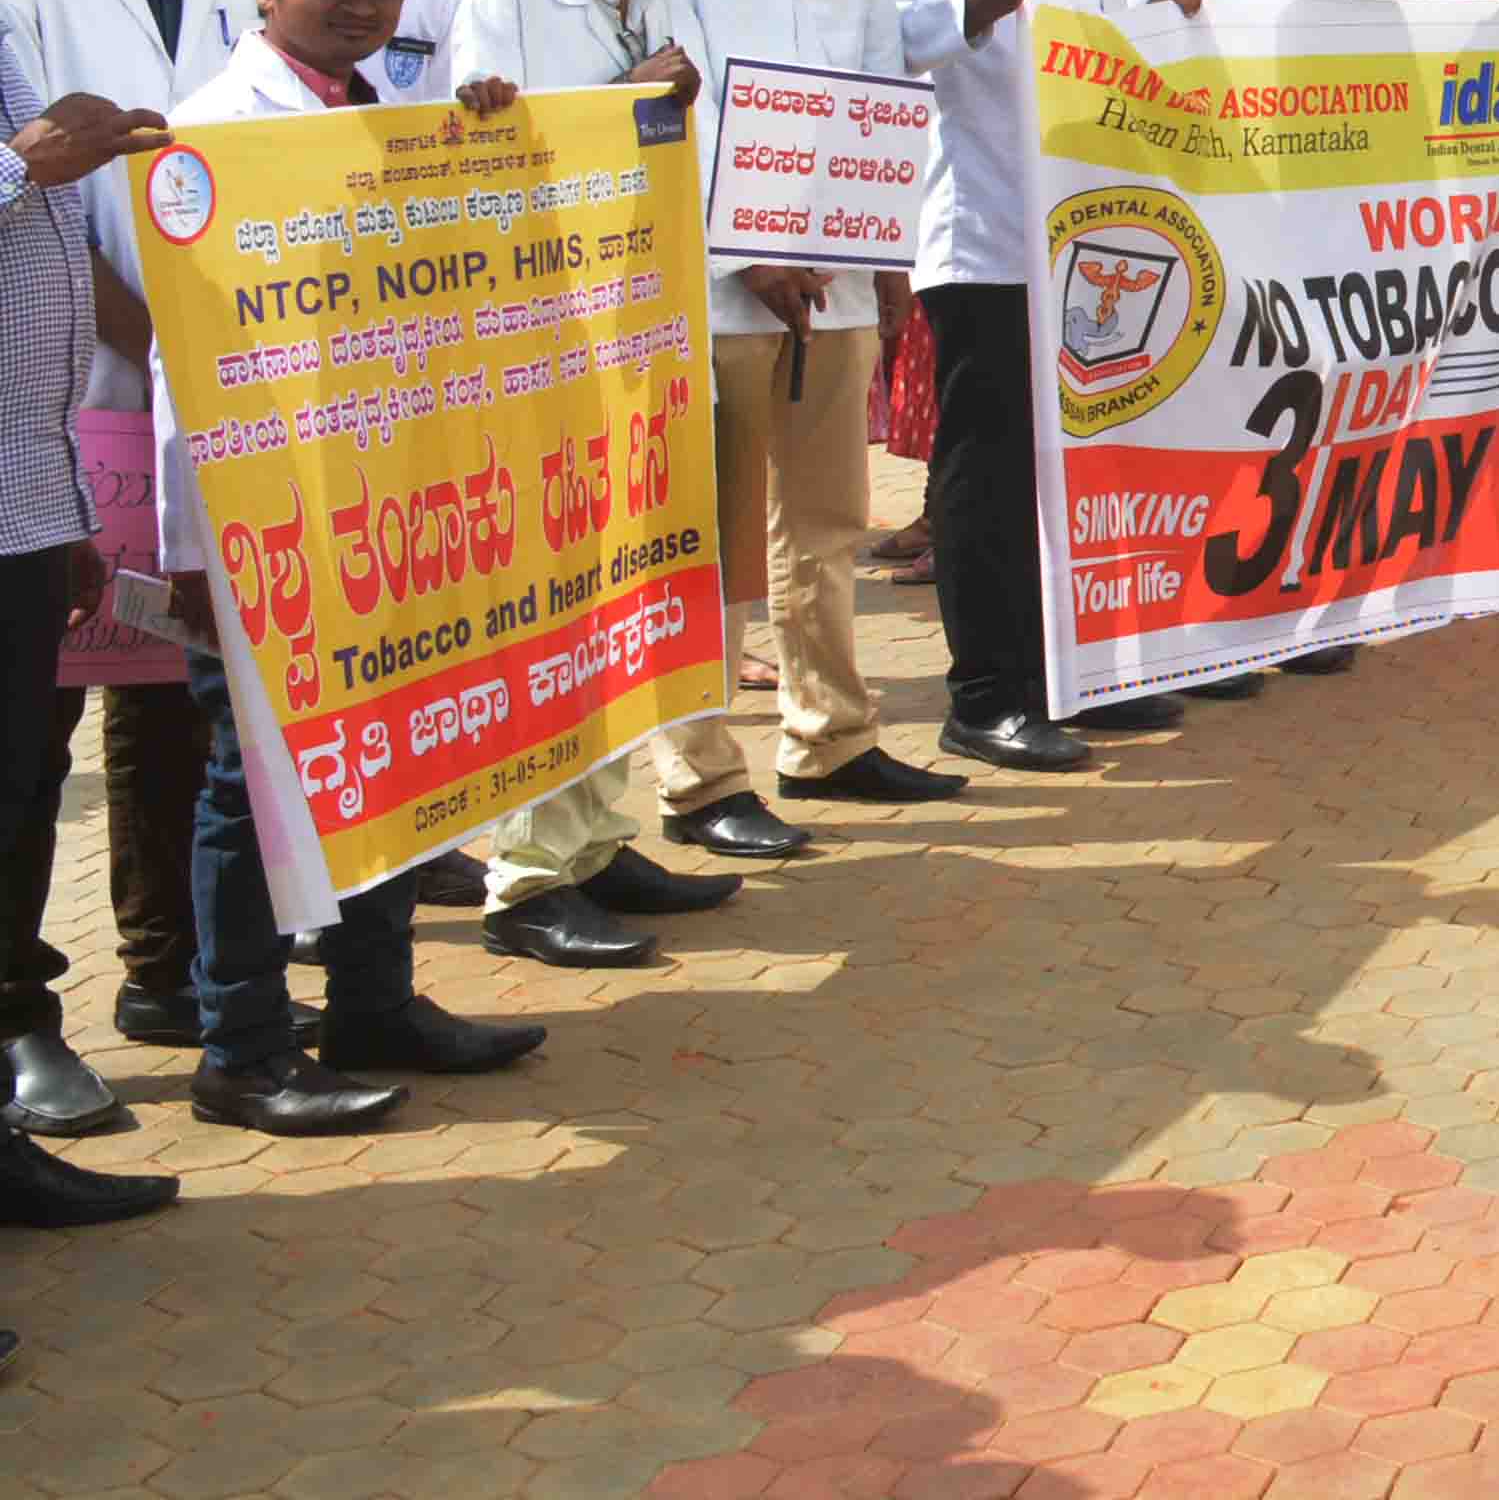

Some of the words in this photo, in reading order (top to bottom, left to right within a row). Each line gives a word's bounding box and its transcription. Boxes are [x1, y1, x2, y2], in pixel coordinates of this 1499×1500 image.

[732, 80, 836, 118] ತಂಬಾಕು
[1218, 82, 1410, 120] ASSOCIATION
[733, 141, 817, 176] ಪರಿಸರ
[1242, 122, 1370, 157] Karnataka
[733, 203, 811, 235] ಜೀವನ
[235, 272, 360, 326] NTCP,
[377, 250, 497, 304] NOHP,
[512, 233, 592, 282] HIMS,
[598, 223, 654, 262] ಹಾಸನ
[1070, 199, 1150, 226] DENTAL
[1154, 206, 1217, 307] ASSOCIATION
[1230, 276, 1311, 368] NO
[1087, 374, 1161, 423] BRANCH
[1073, 491, 1210, 545] SMOKING
[1307, 426, 1497, 577] MAY
[220, 477, 321, 712] ವಿಶ್ವ
[329, 434, 517, 617] ತಂಬಾಕು
[540, 421, 612, 555] ರಹಿತ
[1073, 571, 1133, 616] Your
[1137, 560, 1184, 605] life
[333, 612, 472, 692] Tobacco
[485, 586, 538, 638] and
[550, 567, 603, 619] heart
[610, 526, 701, 586] disease
[527, 582, 686, 707] ಕಾರ್ಯಕ್ರಮ
[489, 736, 582, 800] 31-05-2018
